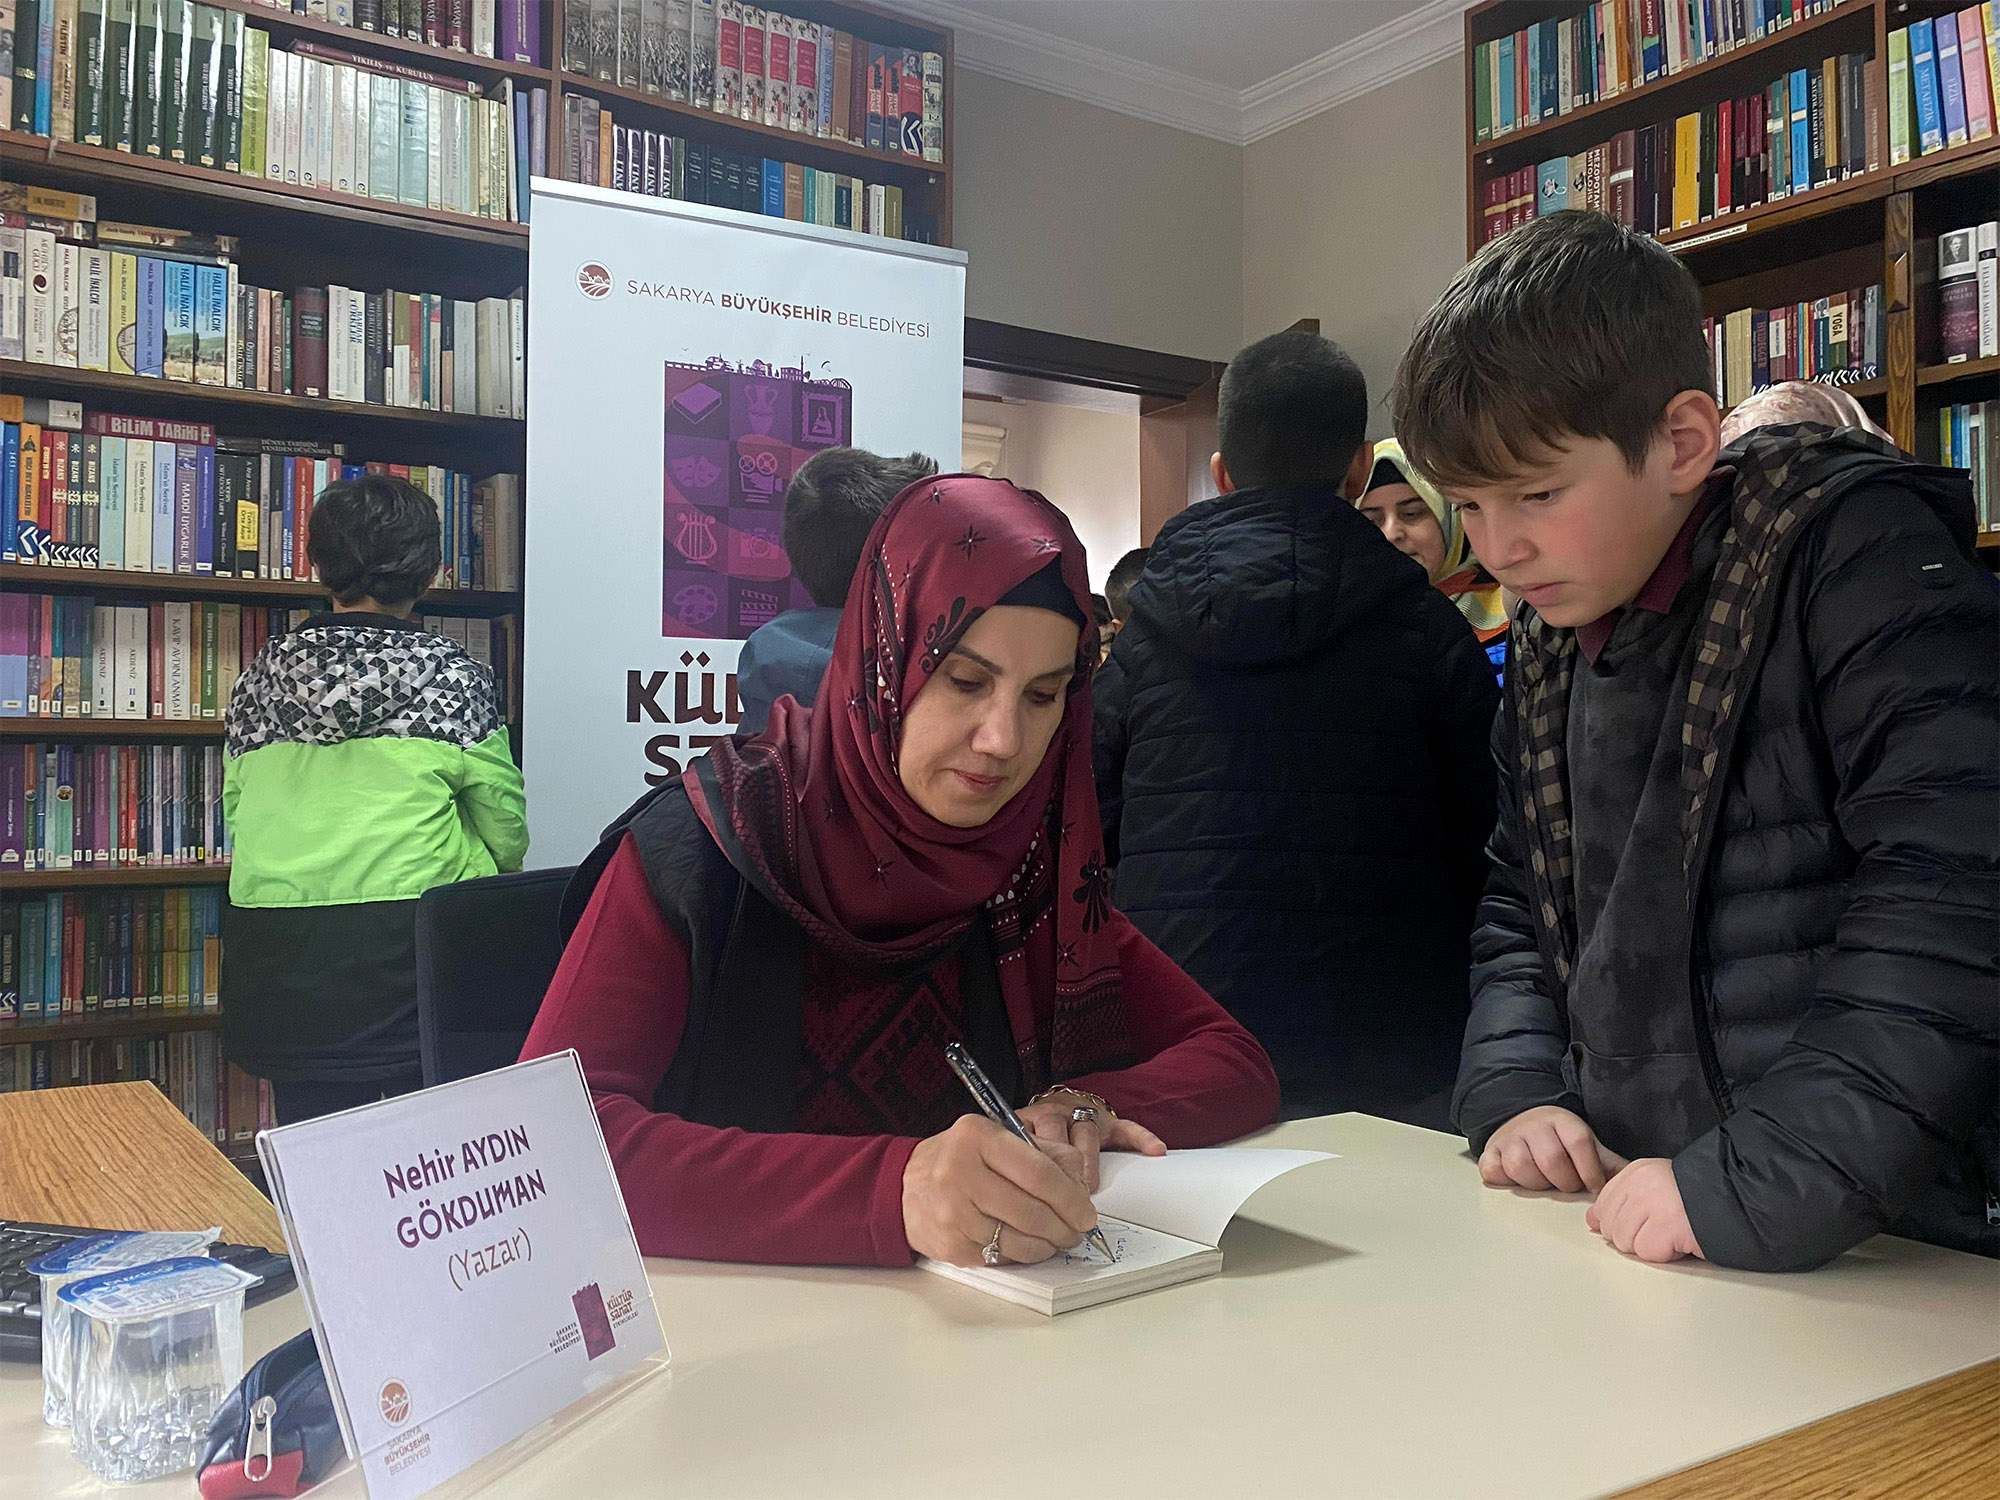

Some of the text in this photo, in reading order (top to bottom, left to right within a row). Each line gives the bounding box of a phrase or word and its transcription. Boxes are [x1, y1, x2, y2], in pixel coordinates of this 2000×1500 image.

[351, 54, 383, 70] YIKILIŞ
[396, 65, 434, 81] KURULUŞ
[1919, 68, 1934, 125] METAFİZİK
[0, 212, 25, 228] SLAR
[89, 257, 102, 305] HALİL İNALCIK
[180, 268, 190, 328] HALİL İNALCIK
[211, 272, 222, 332] HALİL İNALCIK
[349, 298, 357, 343] TÜRKLER
[627, 279, 931, 338] SAKARYA BÜYÜKŞEHİR BELEDİYESİ
[1832, 312, 1843, 336] YOGA
[1757, 321, 1766, 368] HEIDEGGER
[111, 417, 199, 441] BİLİM TARİHİ
[56, 458, 64, 481] BİZANS
[71, 461, 79, 483] BİZANS
[87, 461, 95, 483] BİZANS
[180, 482, 191, 559] MADDİ UYGARLIK
[172, 618, 181, 708] KAYIP AYDINLANMA
[627, 650, 745, 724] KÜL
[383, 1124, 531, 1198] Nehir AYDIN
[397, 1168, 547, 1248] GÖKDUMAN
[448, 1227, 532, 1291] (Yazar)
[606, 1290, 634, 1311] KÜLTÜR
[384, 1433, 431, 1465] BÜYÜKŞEHİR
[386, 1425, 422, 1449] SAKARYA
[389, 1447, 432, 1476] BELEDİYESİ
